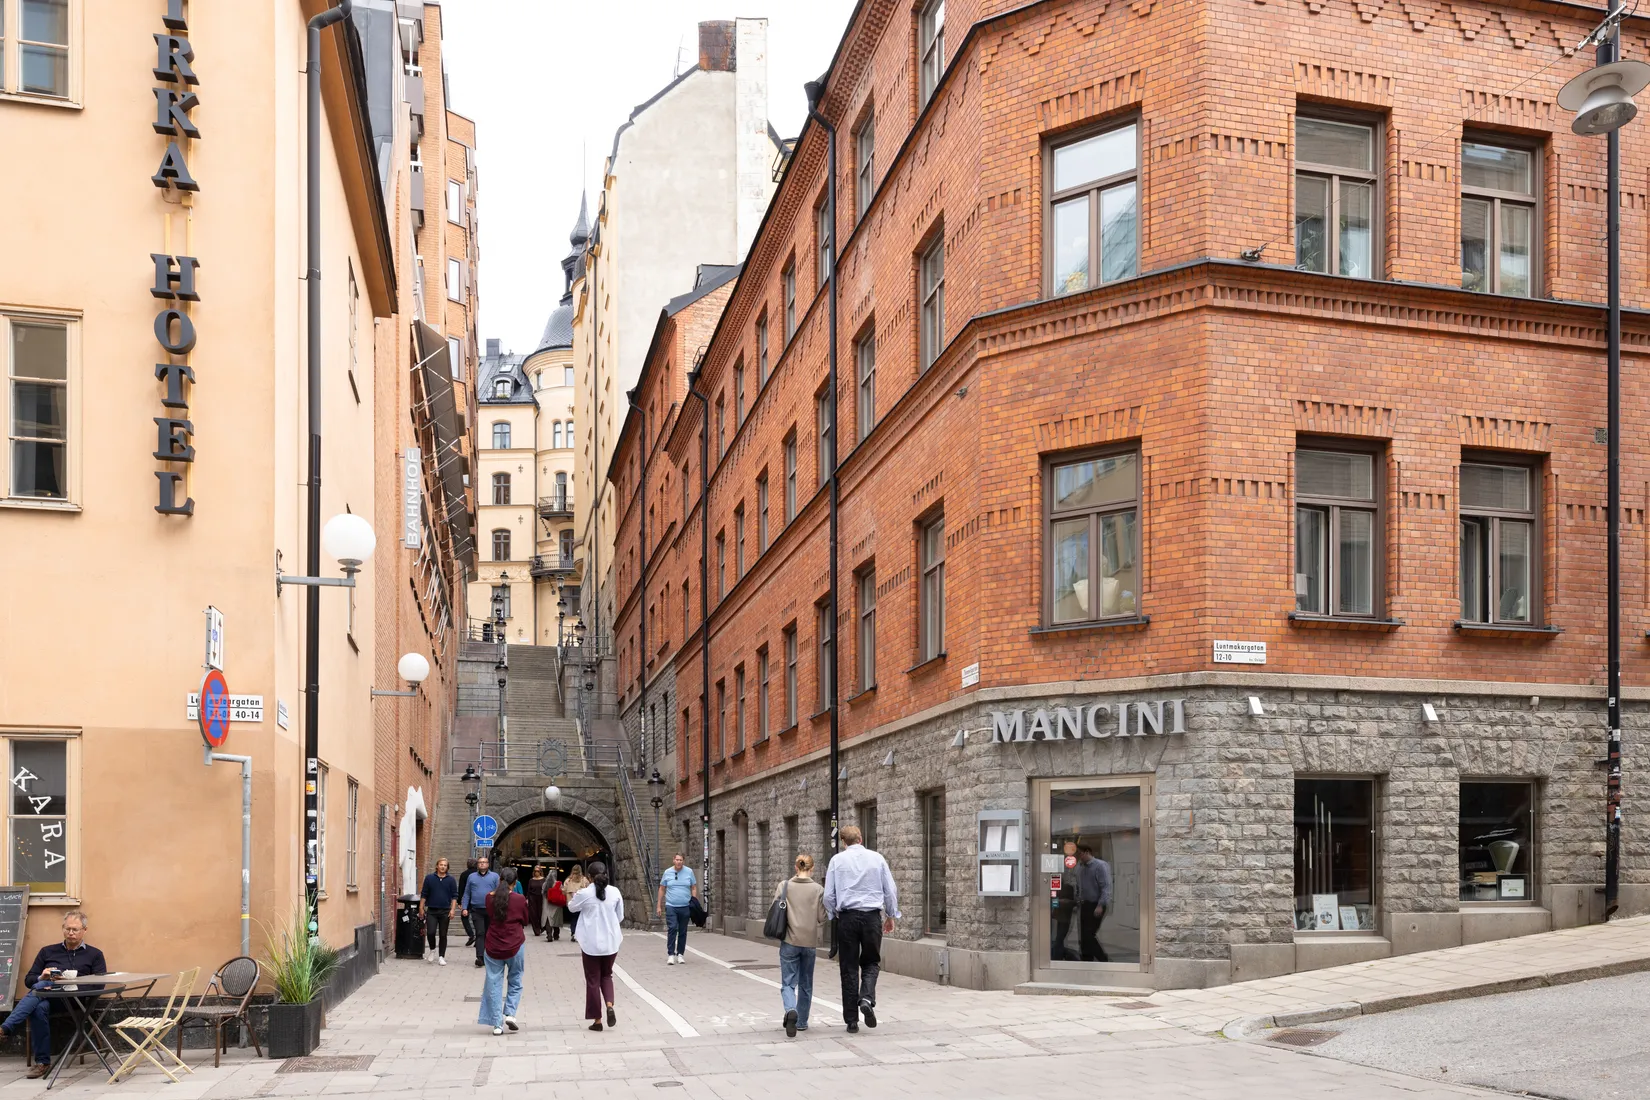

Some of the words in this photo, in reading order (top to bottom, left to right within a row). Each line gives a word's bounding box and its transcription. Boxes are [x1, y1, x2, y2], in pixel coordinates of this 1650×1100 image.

[150, 253, 201, 516] HOTEL
[407, 450, 419, 545] BAHNHOF
[1216, 642, 1264, 653] Luntmakargatan
[1216, 653, 1232, 661] 12-10
[990, 699, 1187, 744] MANCINI
[9, 766, 66, 869] KARA
